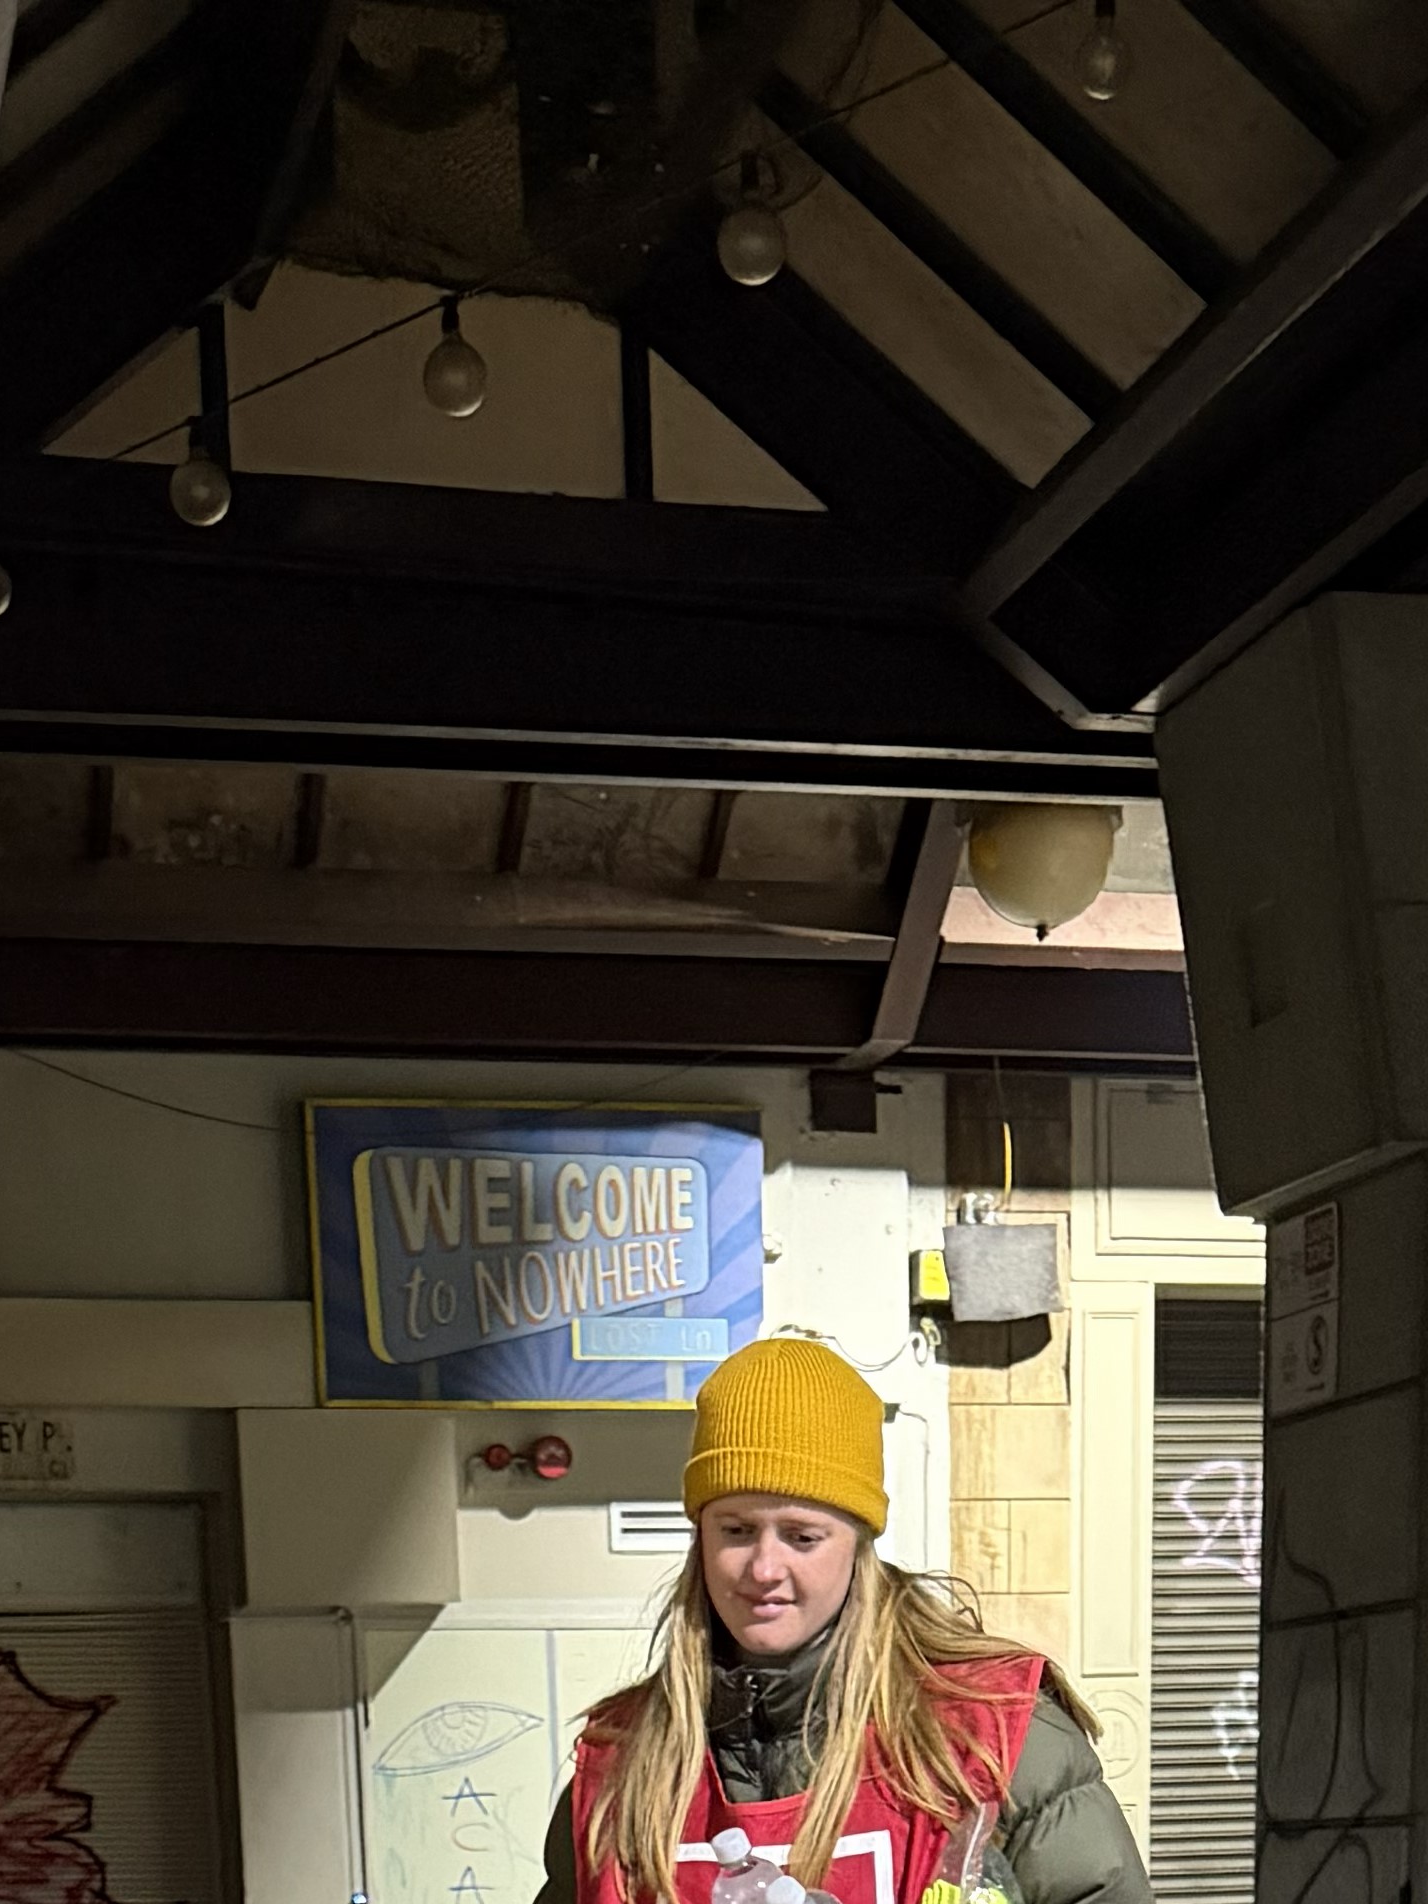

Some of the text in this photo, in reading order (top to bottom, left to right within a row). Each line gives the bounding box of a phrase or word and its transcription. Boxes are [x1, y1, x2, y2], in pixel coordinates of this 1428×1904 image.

[387, 1155, 694, 1253] WELCOME
[405, 1238, 687, 1341] to NOWHERE
